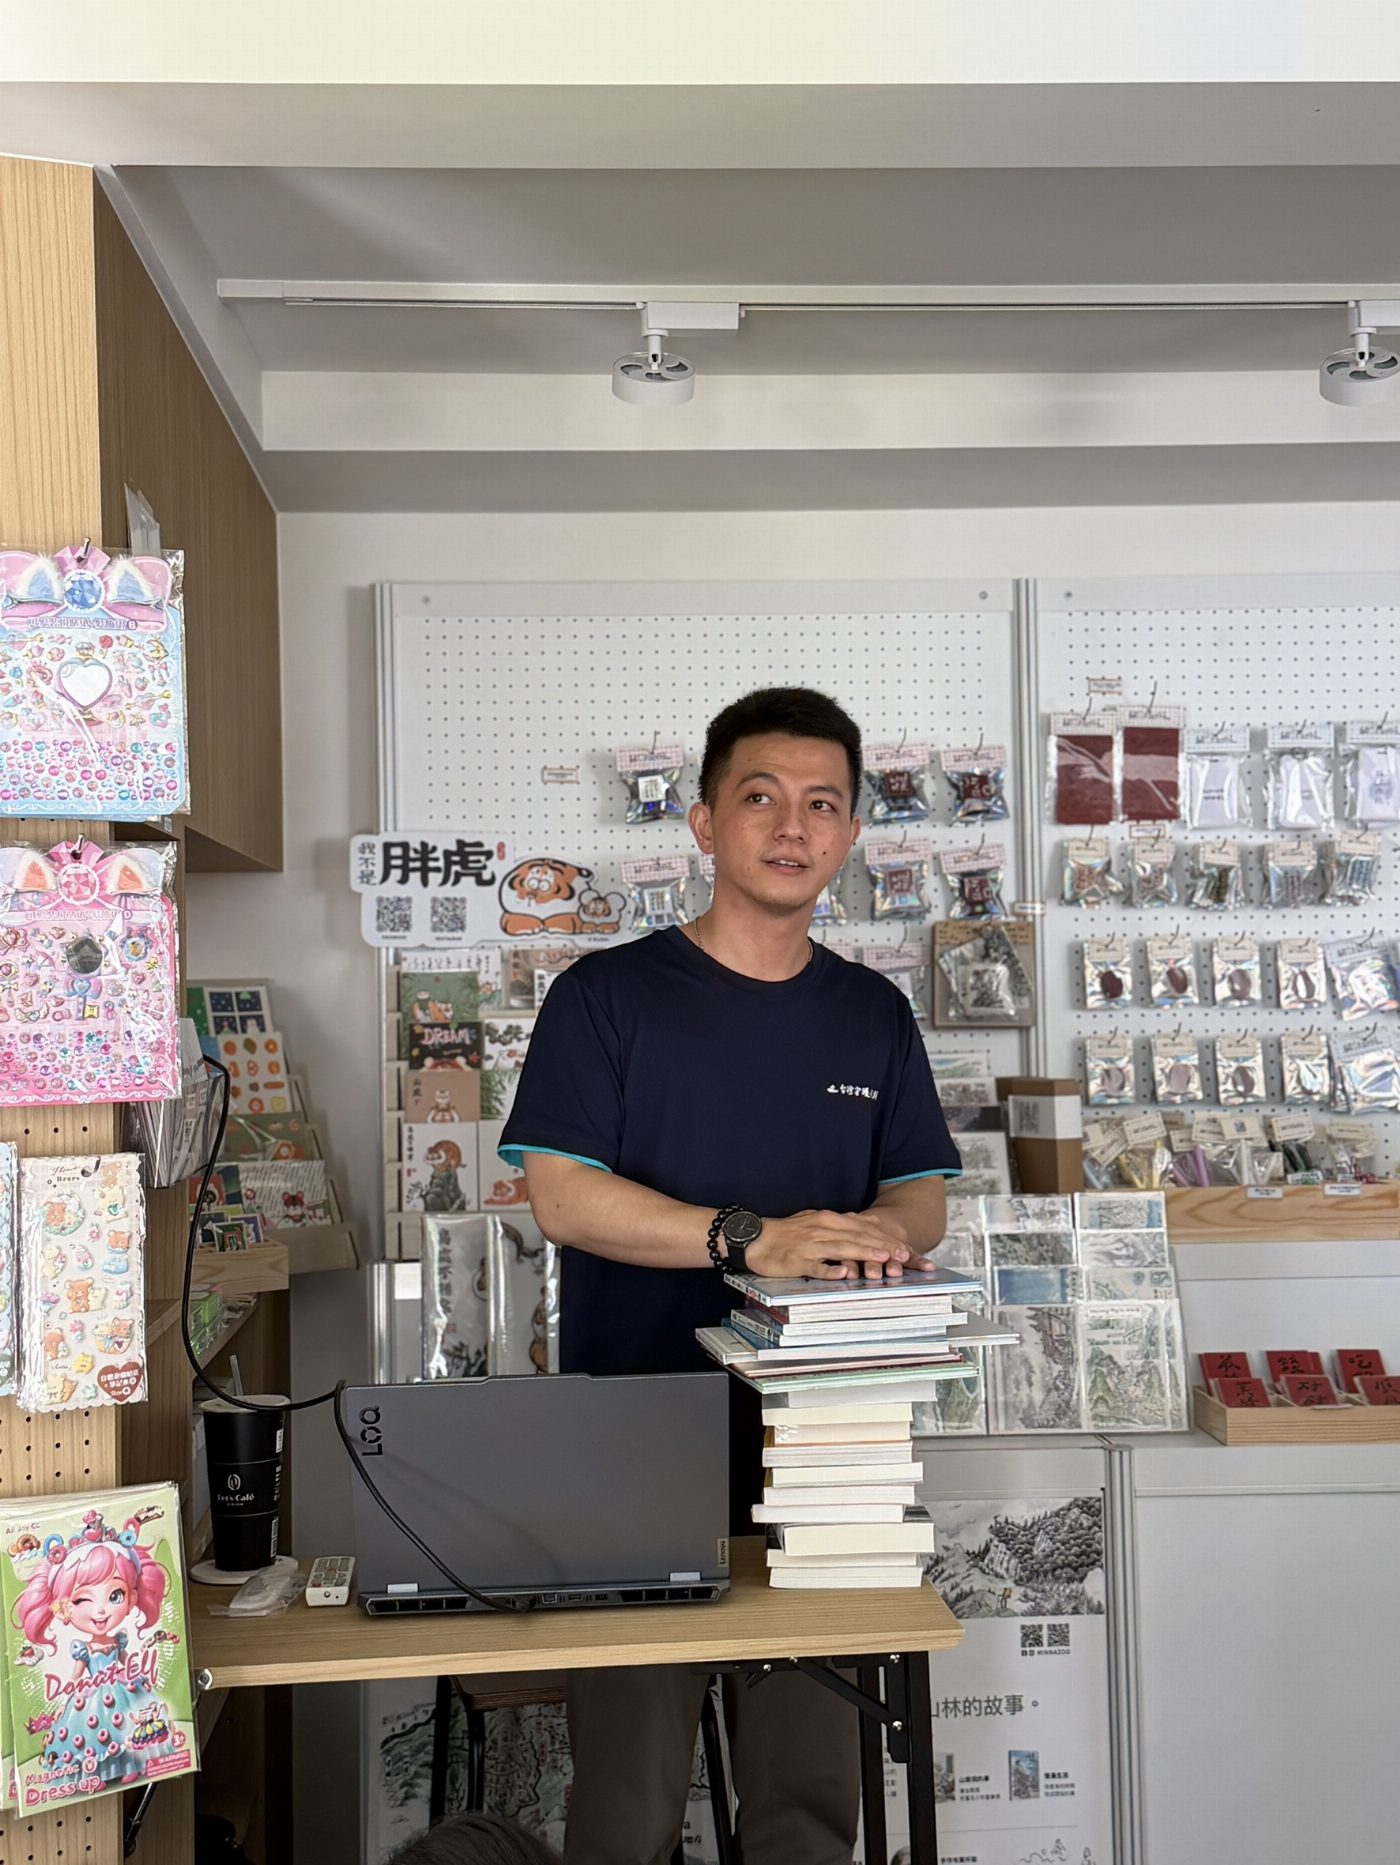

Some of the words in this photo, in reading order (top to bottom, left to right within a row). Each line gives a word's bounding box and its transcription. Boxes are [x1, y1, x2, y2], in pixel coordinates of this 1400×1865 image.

[357, 841, 377, 886] 我不是
[379, 839, 496, 888] 胖虎
[421, 1027, 472, 1046] DREAM
[359, 1405, 383, 1456] LOQ
[719, 1540, 727, 1565] Lenovo
[126, 1648, 159, 1686] Elf
[25, 1783, 77, 1806] Dress
[78, 1775, 101, 1794] up
